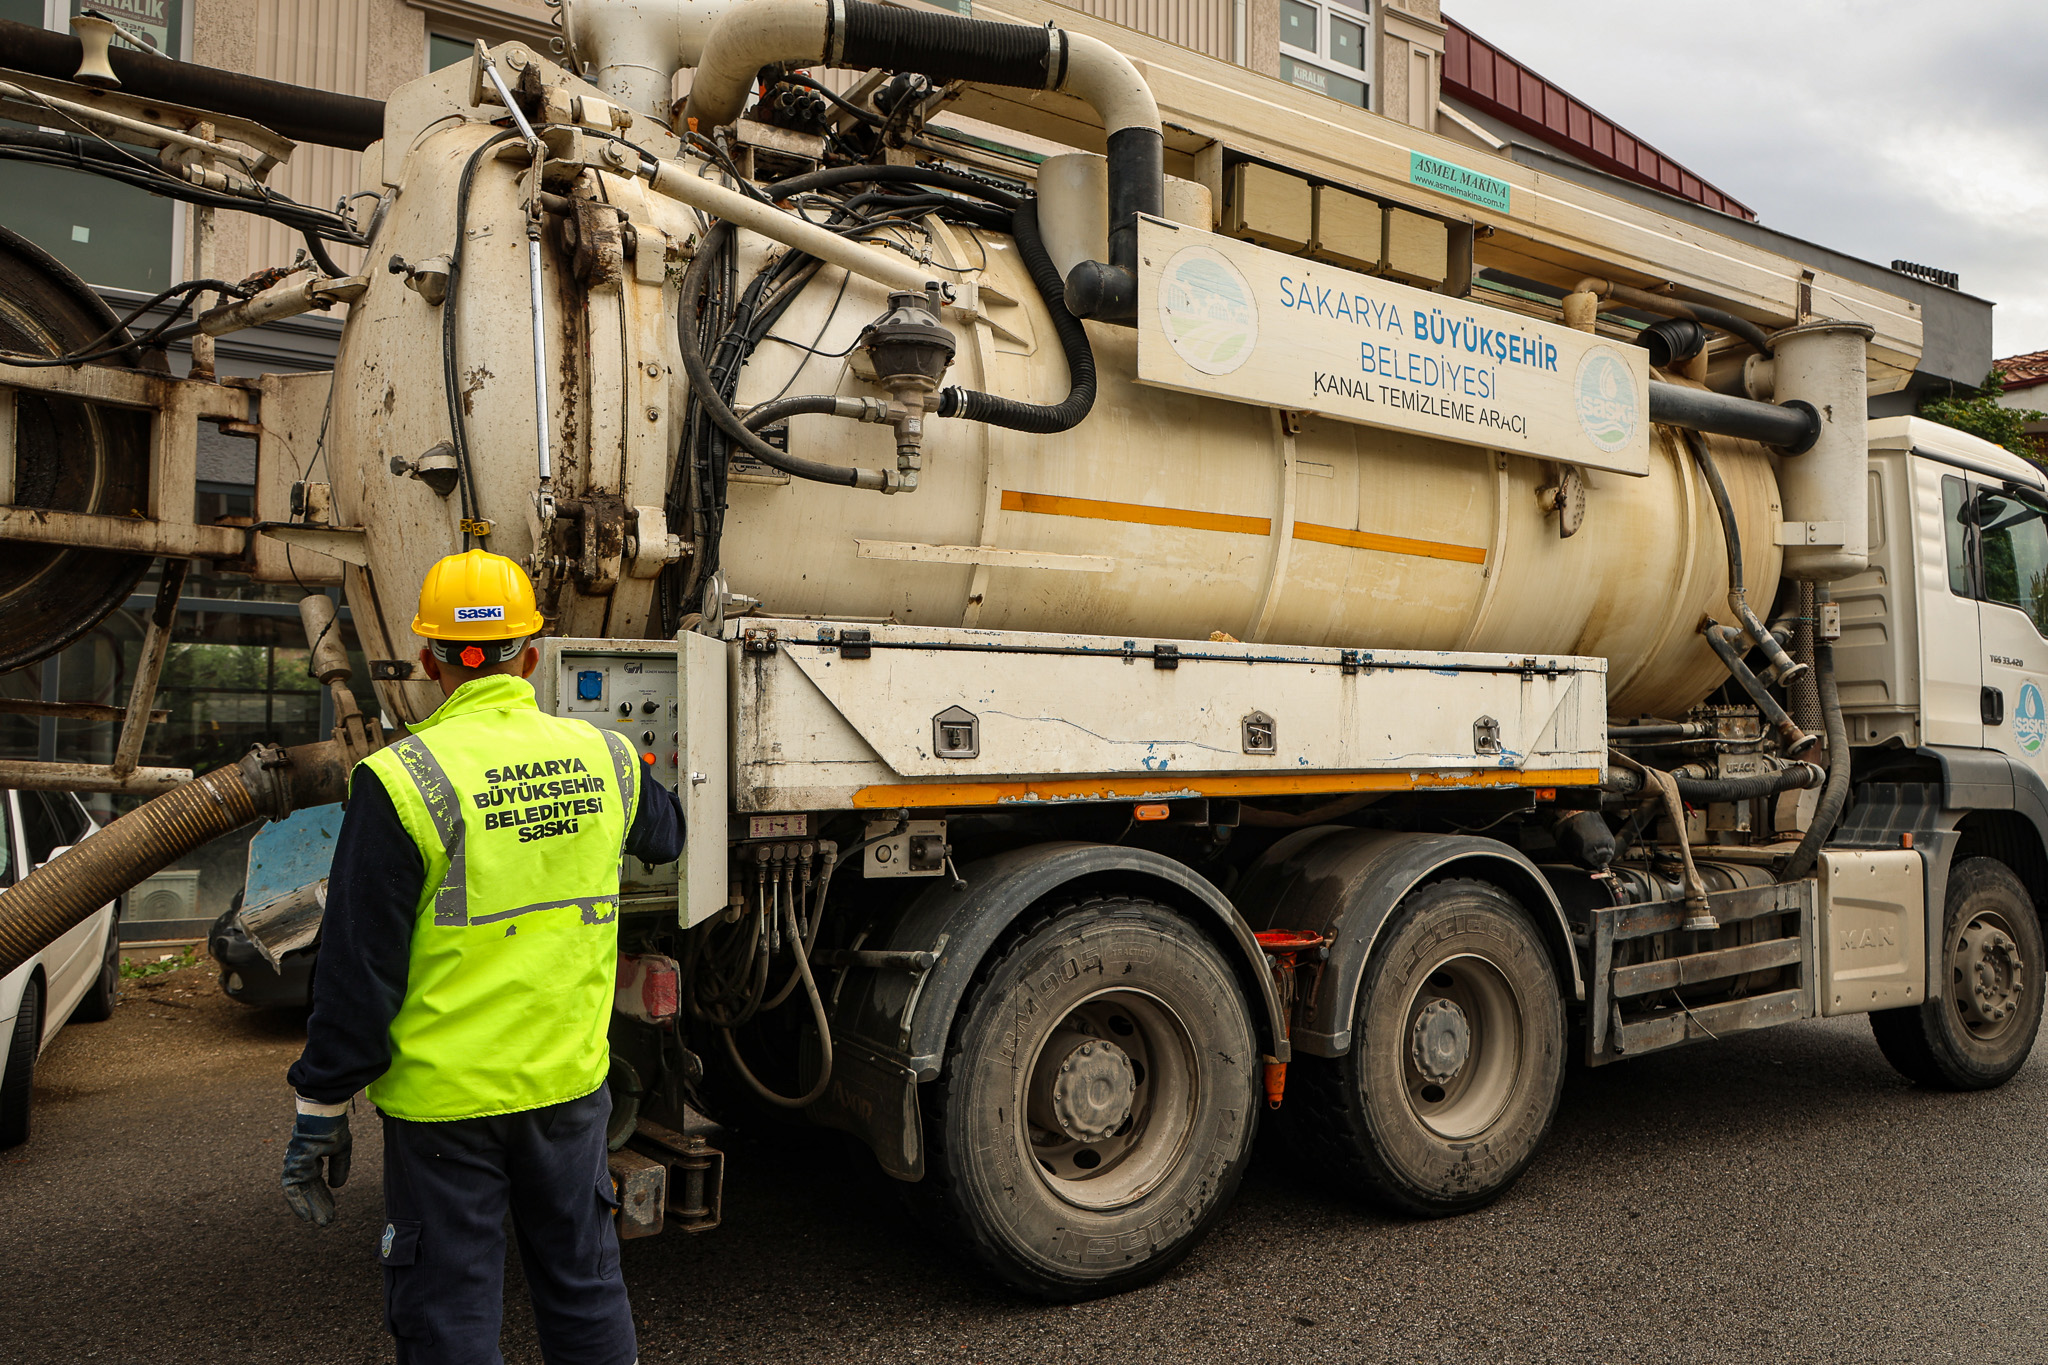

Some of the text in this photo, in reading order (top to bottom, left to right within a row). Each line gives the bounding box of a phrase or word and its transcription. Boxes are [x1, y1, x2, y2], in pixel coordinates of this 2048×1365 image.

[1414, 174, 1505, 209] www.asmelmakina.com.tr
[1415, 158, 1506, 198] ASMEL MAKİNA
[1280, 276, 1558, 372] SAKARYA BÜYÜKŞEHİR
[1361, 341, 1496, 400] BELEDİYESİ
[1314, 371, 1527, 436] KANAL TEMİZLEME ARACI
[484, 757, 588, 784] SAKARYA
[472, 773, 606, 810] BÜYÜKŞEHİR
[1840, 926, 1894, 951] MAN
